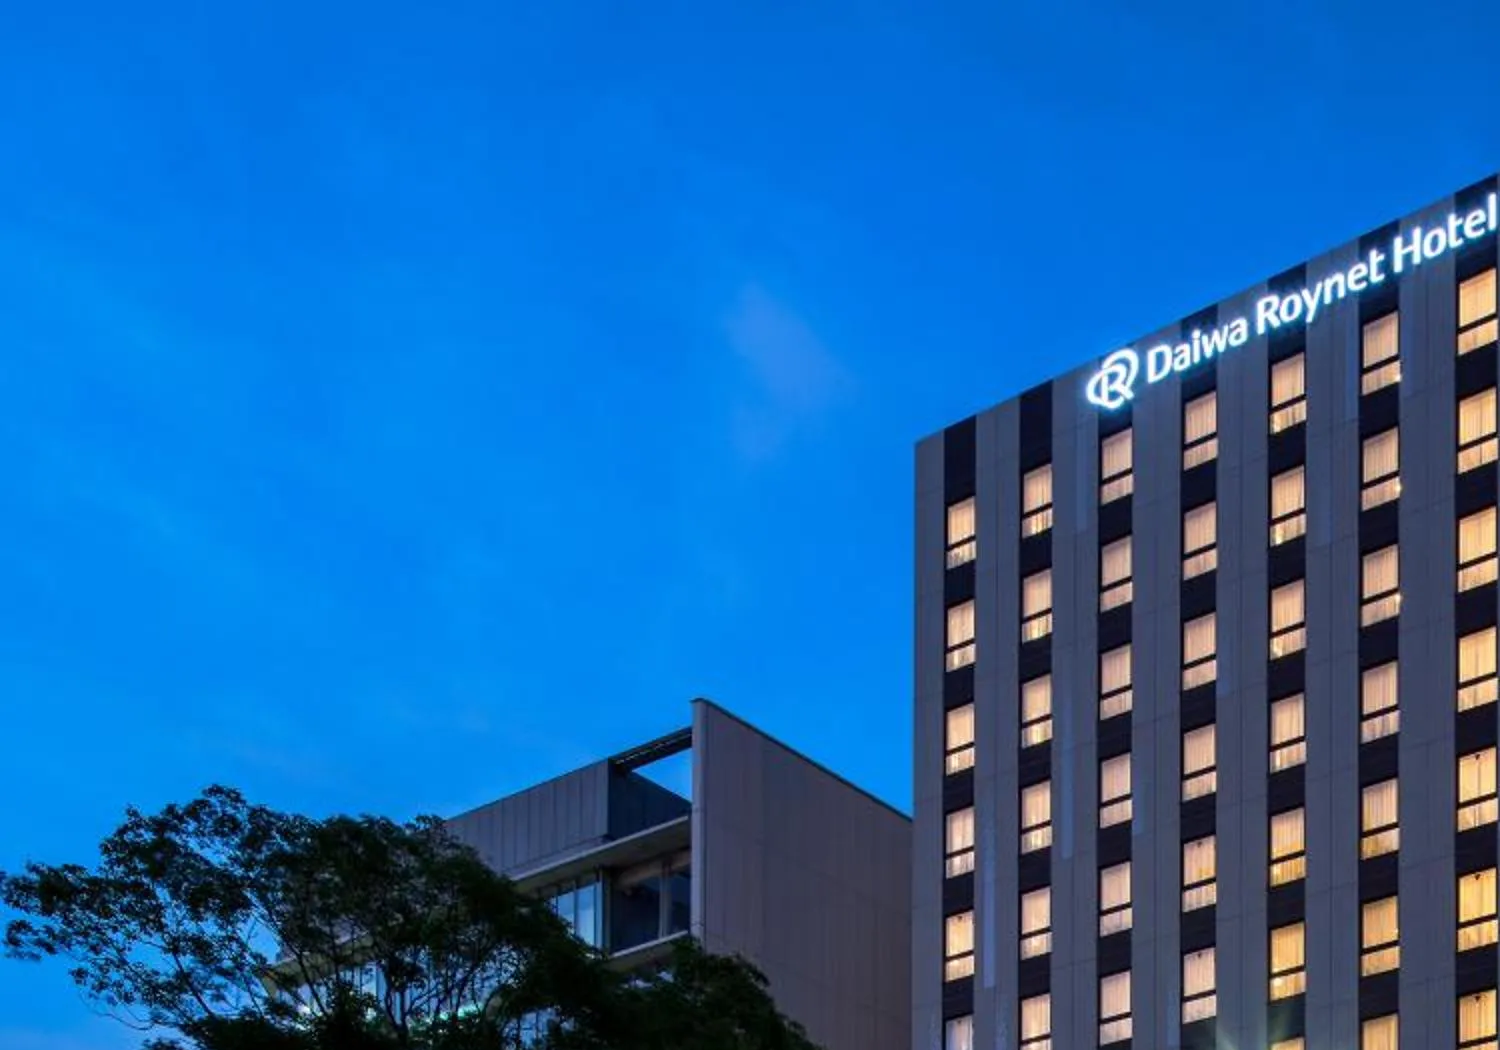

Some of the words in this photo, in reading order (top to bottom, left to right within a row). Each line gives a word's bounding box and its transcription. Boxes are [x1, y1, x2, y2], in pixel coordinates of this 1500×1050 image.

[1146, 316, 1247, 384] Daiwa
[1256, 247, 1385, 337] Roynet
[1393, 193, 1498, 273] Hotel
